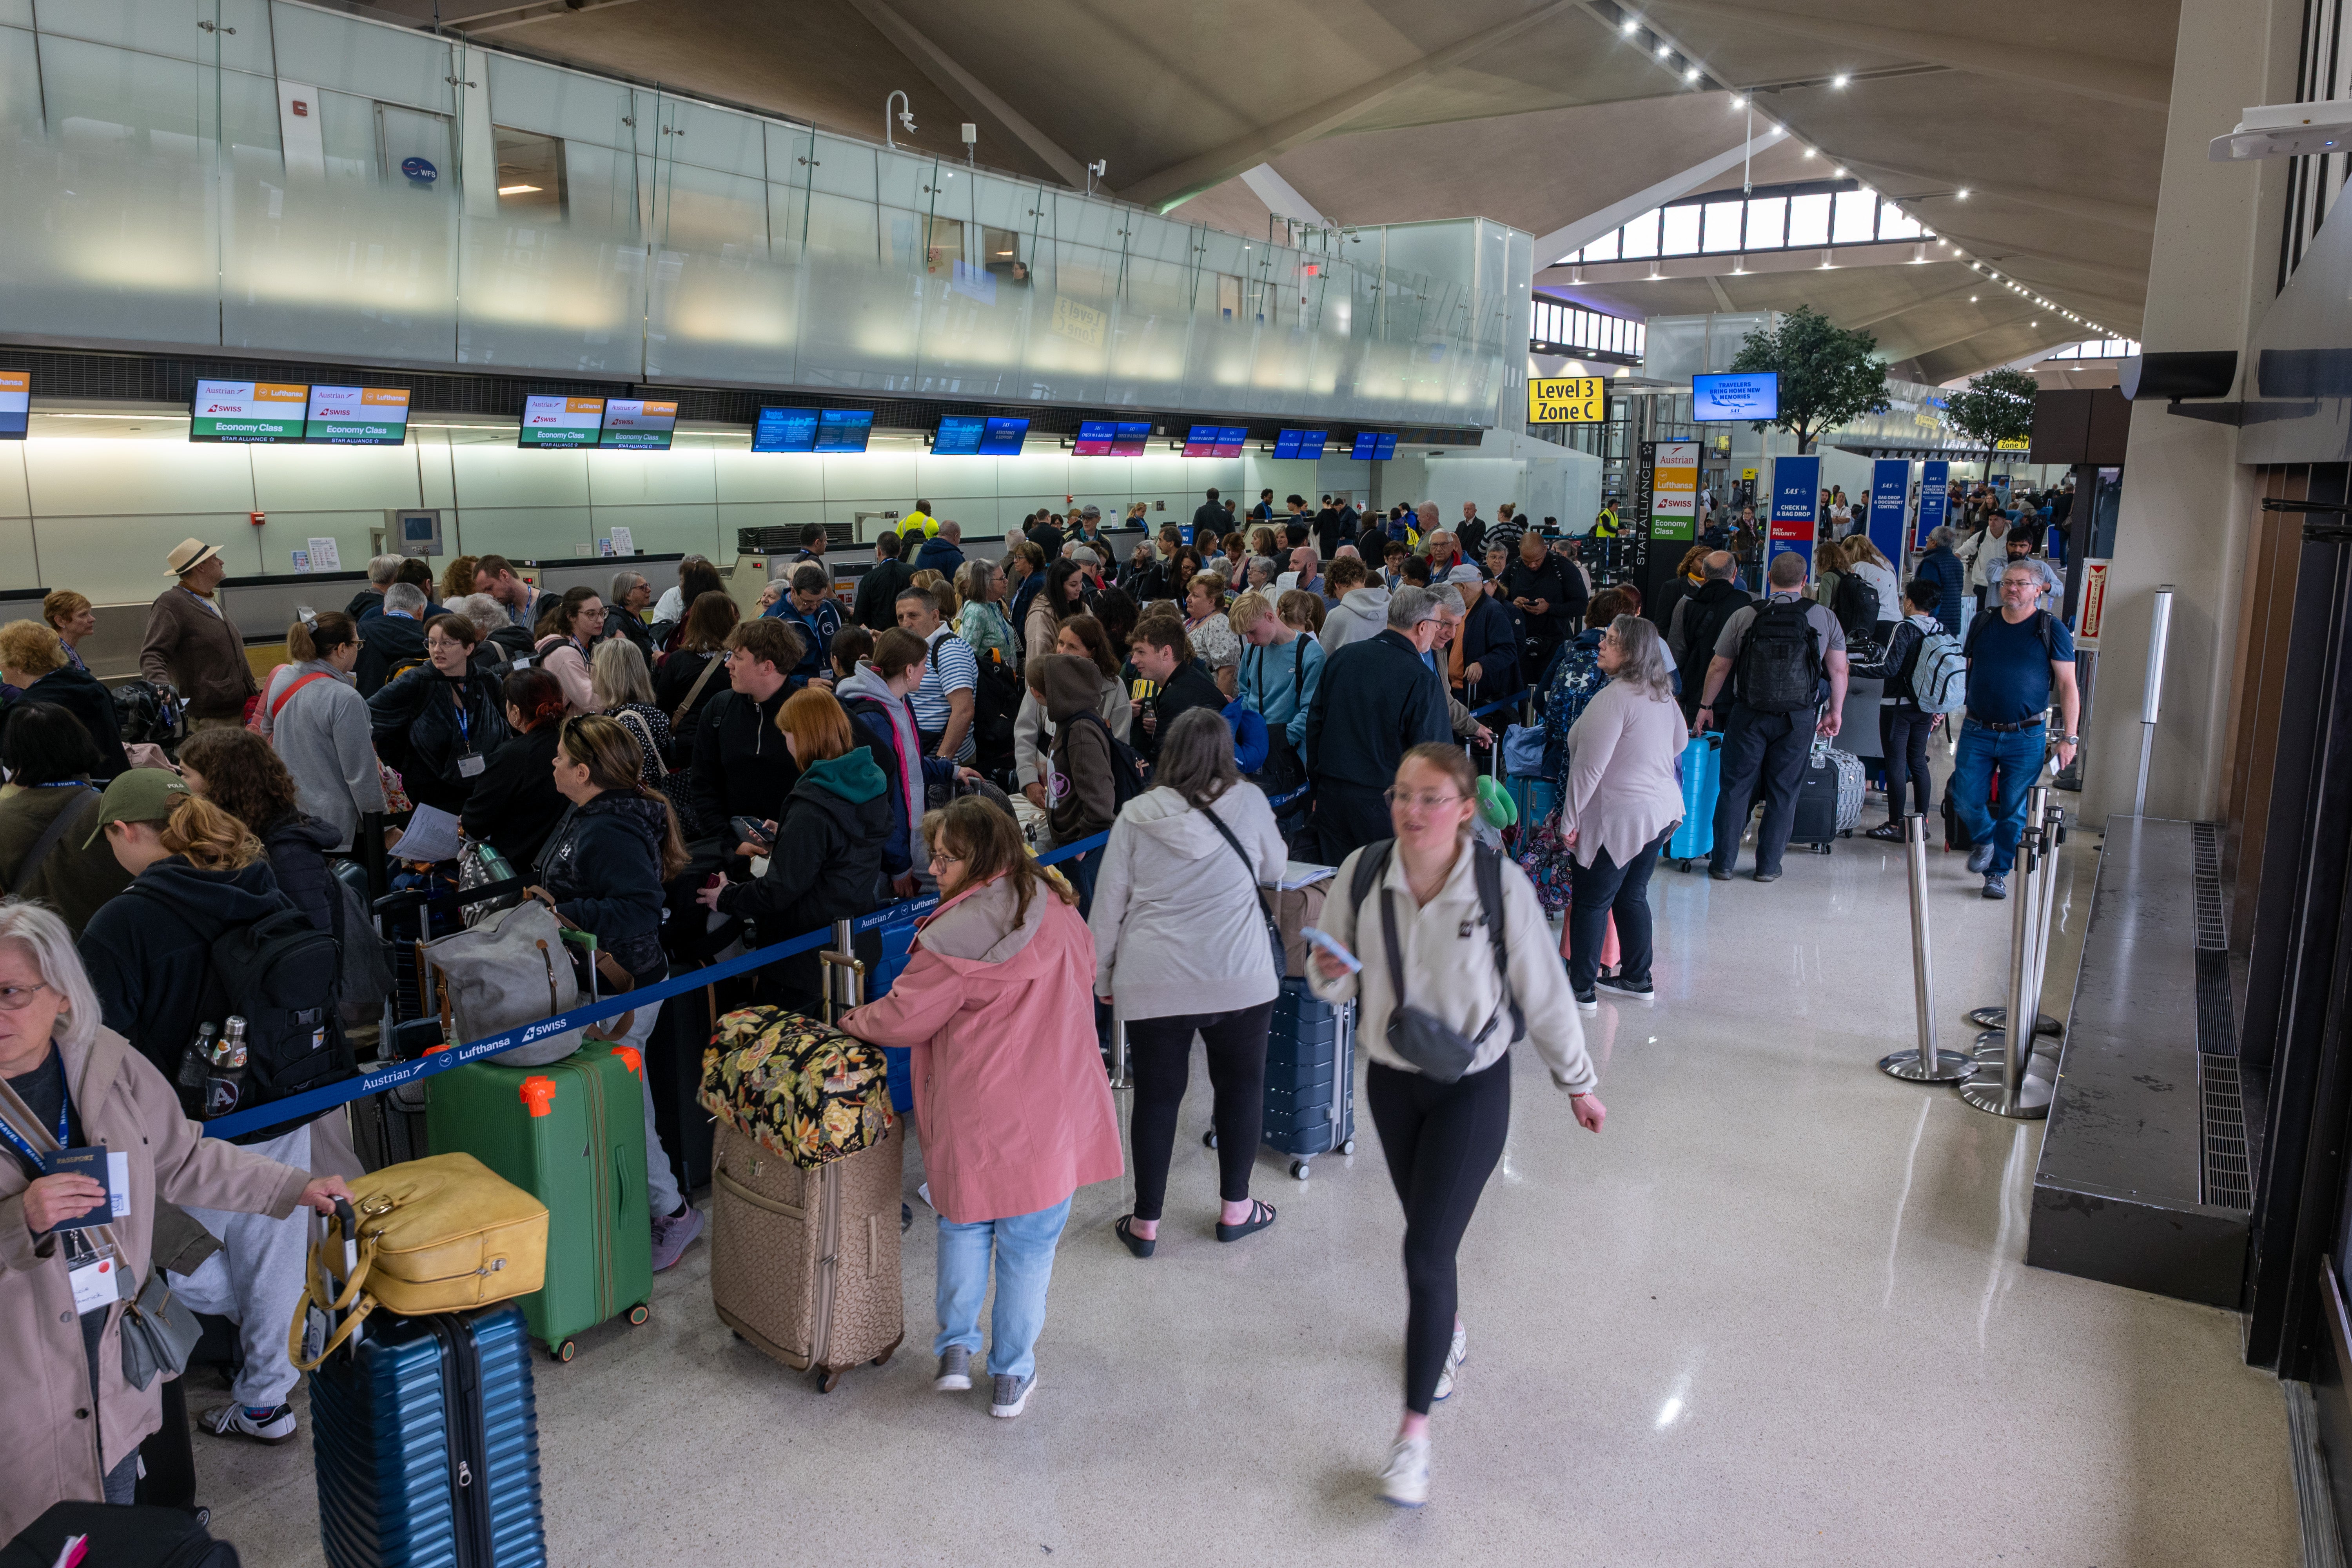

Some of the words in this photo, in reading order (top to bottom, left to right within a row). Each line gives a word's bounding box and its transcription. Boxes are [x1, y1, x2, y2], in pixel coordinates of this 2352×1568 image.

[421, 169, 436, 178] WFS
[1537, 379, 1579, 399] Level
[1585, 380, 1594, 397] 3
[1539, 403, 1579, 420] Zone
[1584, 401, 1593, 419] C
[216, 423, 258, 432] Economy
[327, 425, 364, 435] Economy
[537, 431, 567, 439] Economy
[1660, 456, 1693, 464] Austrian
[1639, 461, 1650, 527] ALLIANCE
[1655, 519, 1687, 528] Economy
[1637, 532, 1646, 565] STAR
[2088, 579, 2099, 630] EXTINGUISHER
[1282, 793, 1295, 802] Lufthansa
[862, 914, 886, 928] Austrian
[911, 897, 939, 911] Lufthansa
[362, 1069, 410, 1091] Austrian
[459, 1038, 510, 1060] Lufthansa
[536, 1018, 566, 1036] SWISS
[212, 1087, 234, 1107] A
[56, 1154, 94, 1164] PASSPORT
